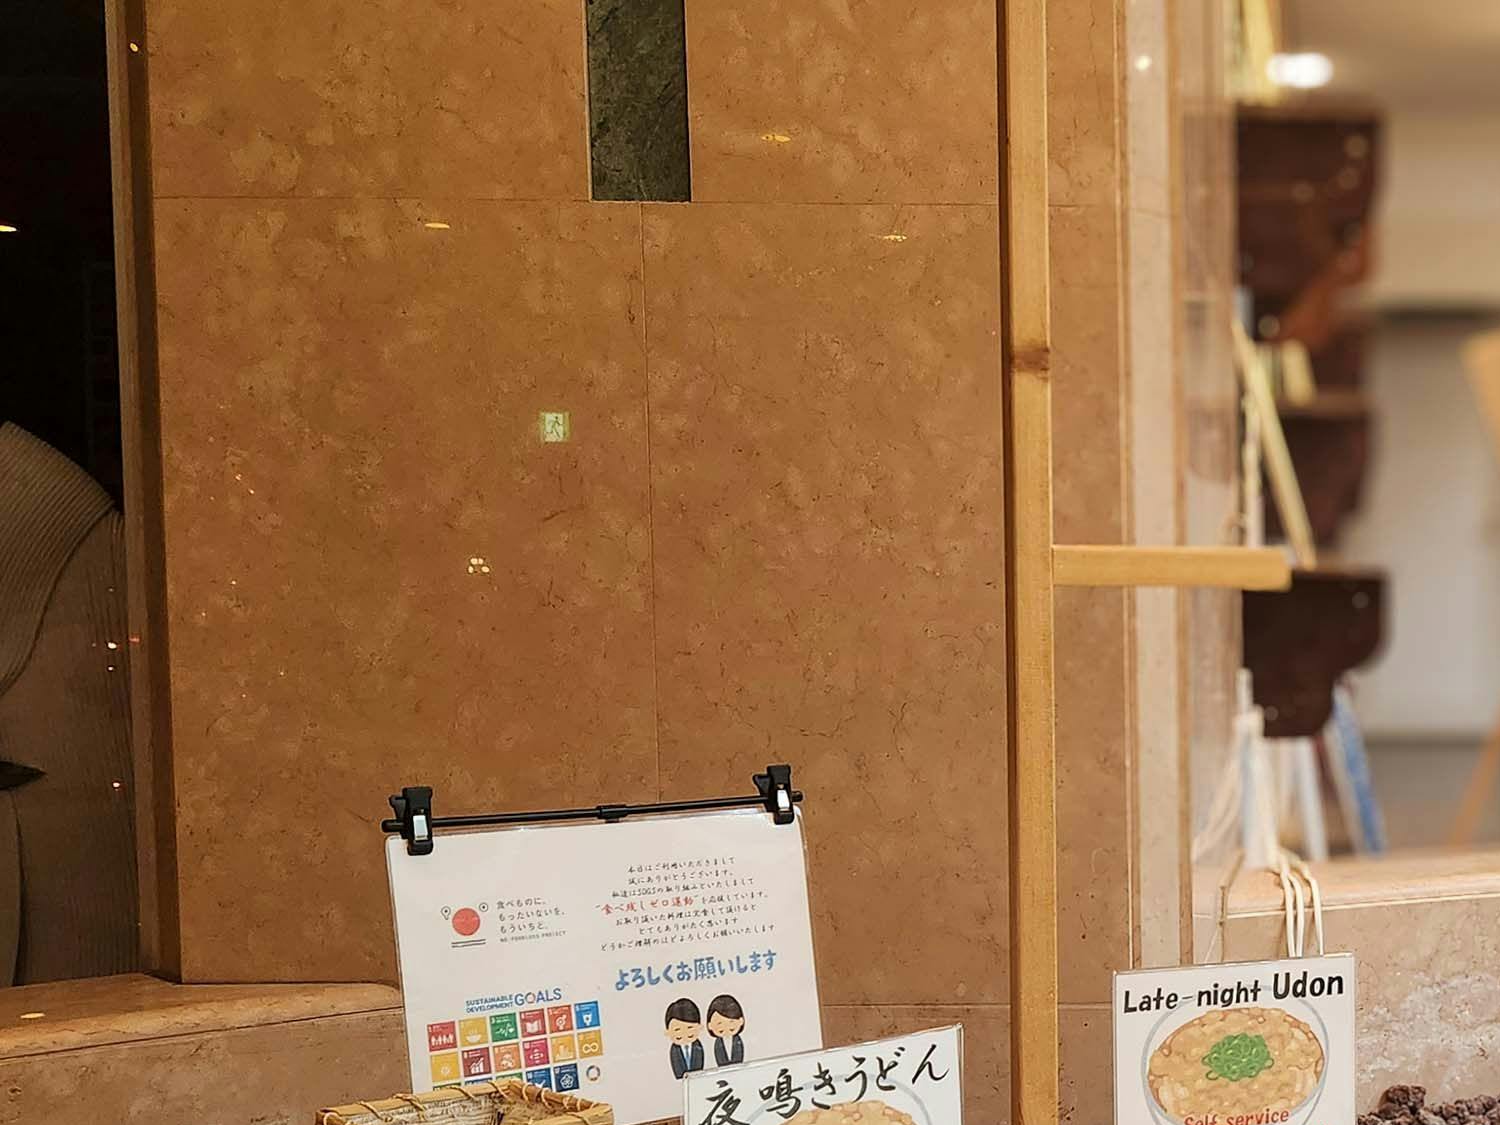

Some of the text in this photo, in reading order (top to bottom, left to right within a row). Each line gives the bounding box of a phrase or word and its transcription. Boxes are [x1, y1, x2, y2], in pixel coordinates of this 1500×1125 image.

[615, 949, 777, 991] よろしくお願いします
[466, 994, 512, 1006] SUSTAINABLE
[514, 988, 562, 1006] GOALS
[1123, 971, 1344, 1013] Late-night Udon
[466, 1001, 513, 1014] DEVELOPMENT
